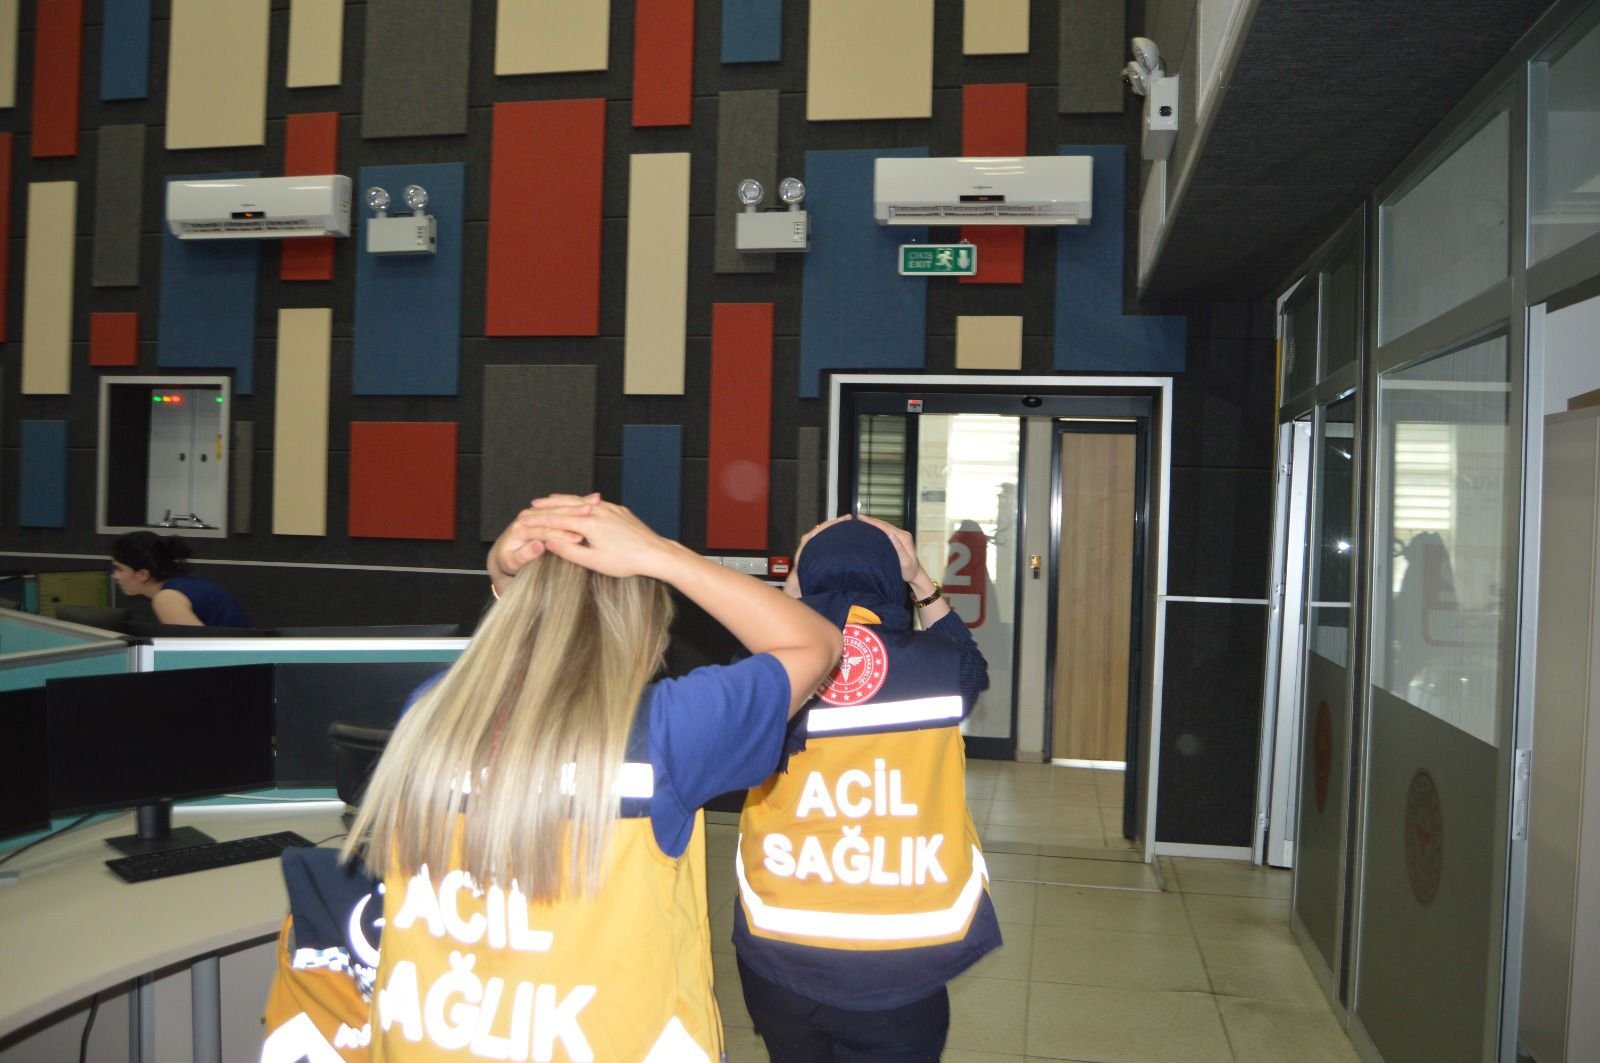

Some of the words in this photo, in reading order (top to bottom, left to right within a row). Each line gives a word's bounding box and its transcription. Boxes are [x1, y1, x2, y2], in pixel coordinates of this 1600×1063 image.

[908, 261, 932, 269] EXIT
[796, 758, 918, 818] ACİL
[763, 825, 948, 886] SAĞLIK
[379, 950, 597, 1063] AĞLIK
